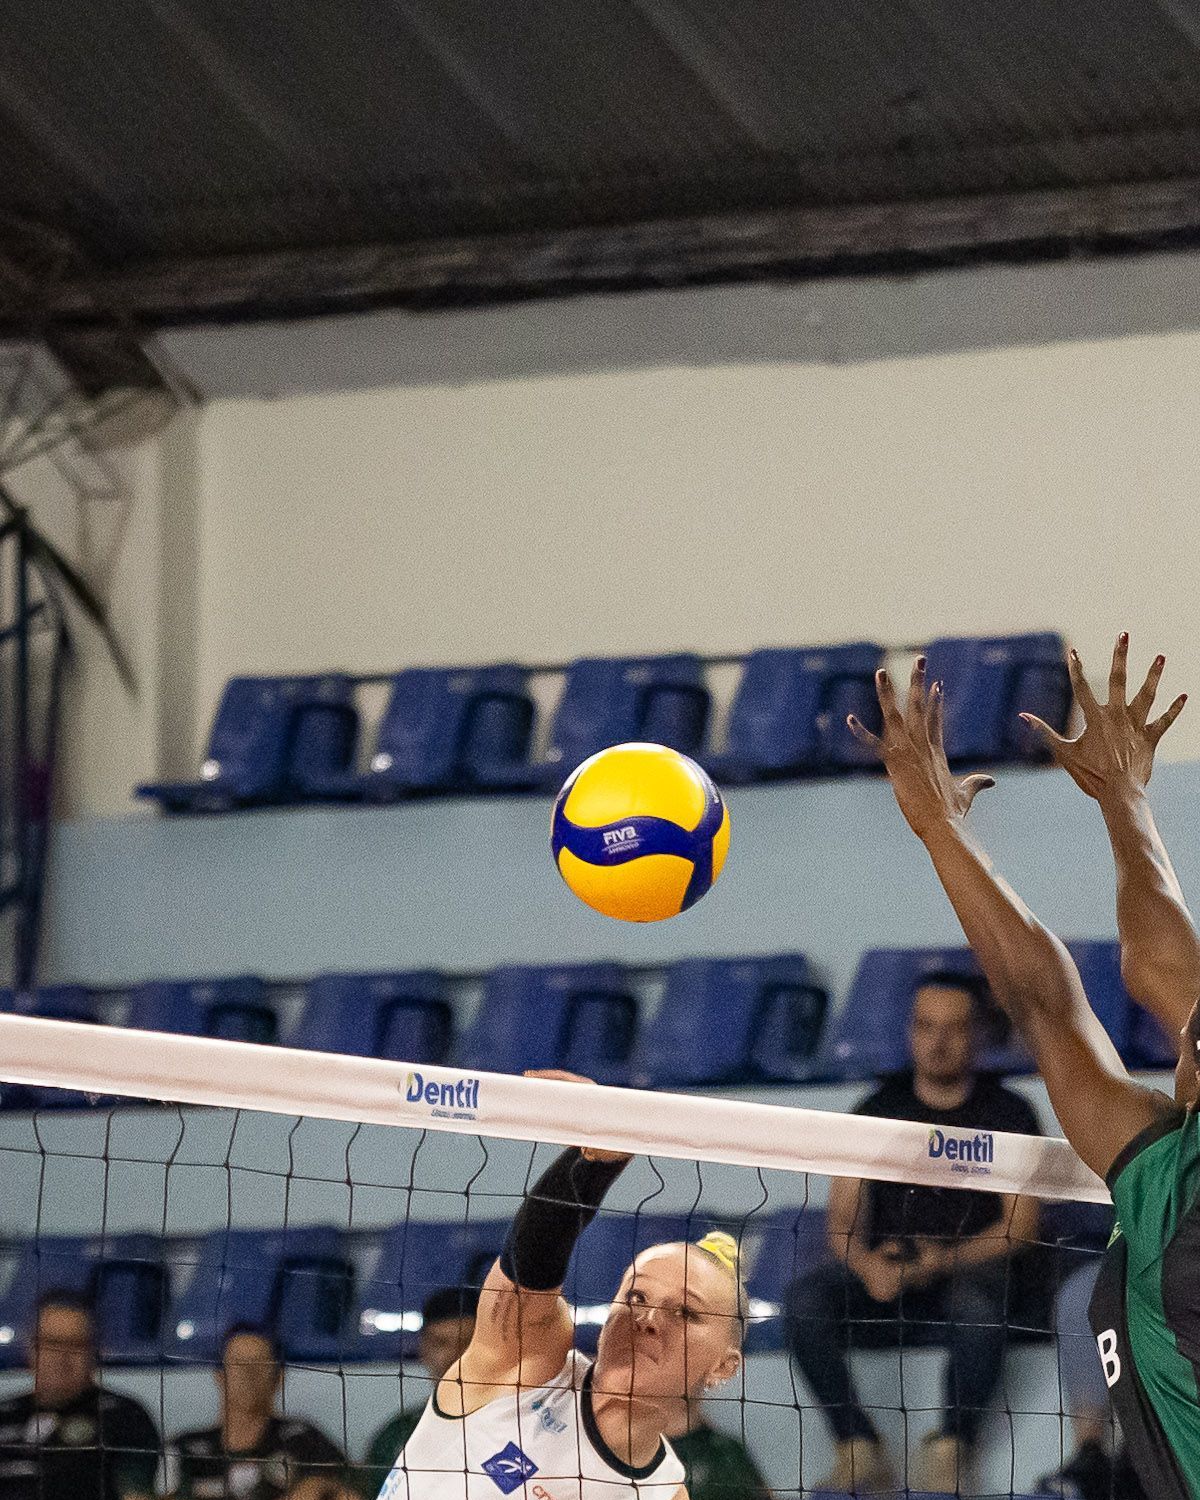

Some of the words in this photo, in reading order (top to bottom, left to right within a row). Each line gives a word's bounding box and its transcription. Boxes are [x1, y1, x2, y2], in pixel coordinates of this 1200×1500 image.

[603, 826, 637, 846] FIVB
[406, 1072, 480, 1108] Dentil
[928, 1127, 994, 1163] Dentil
